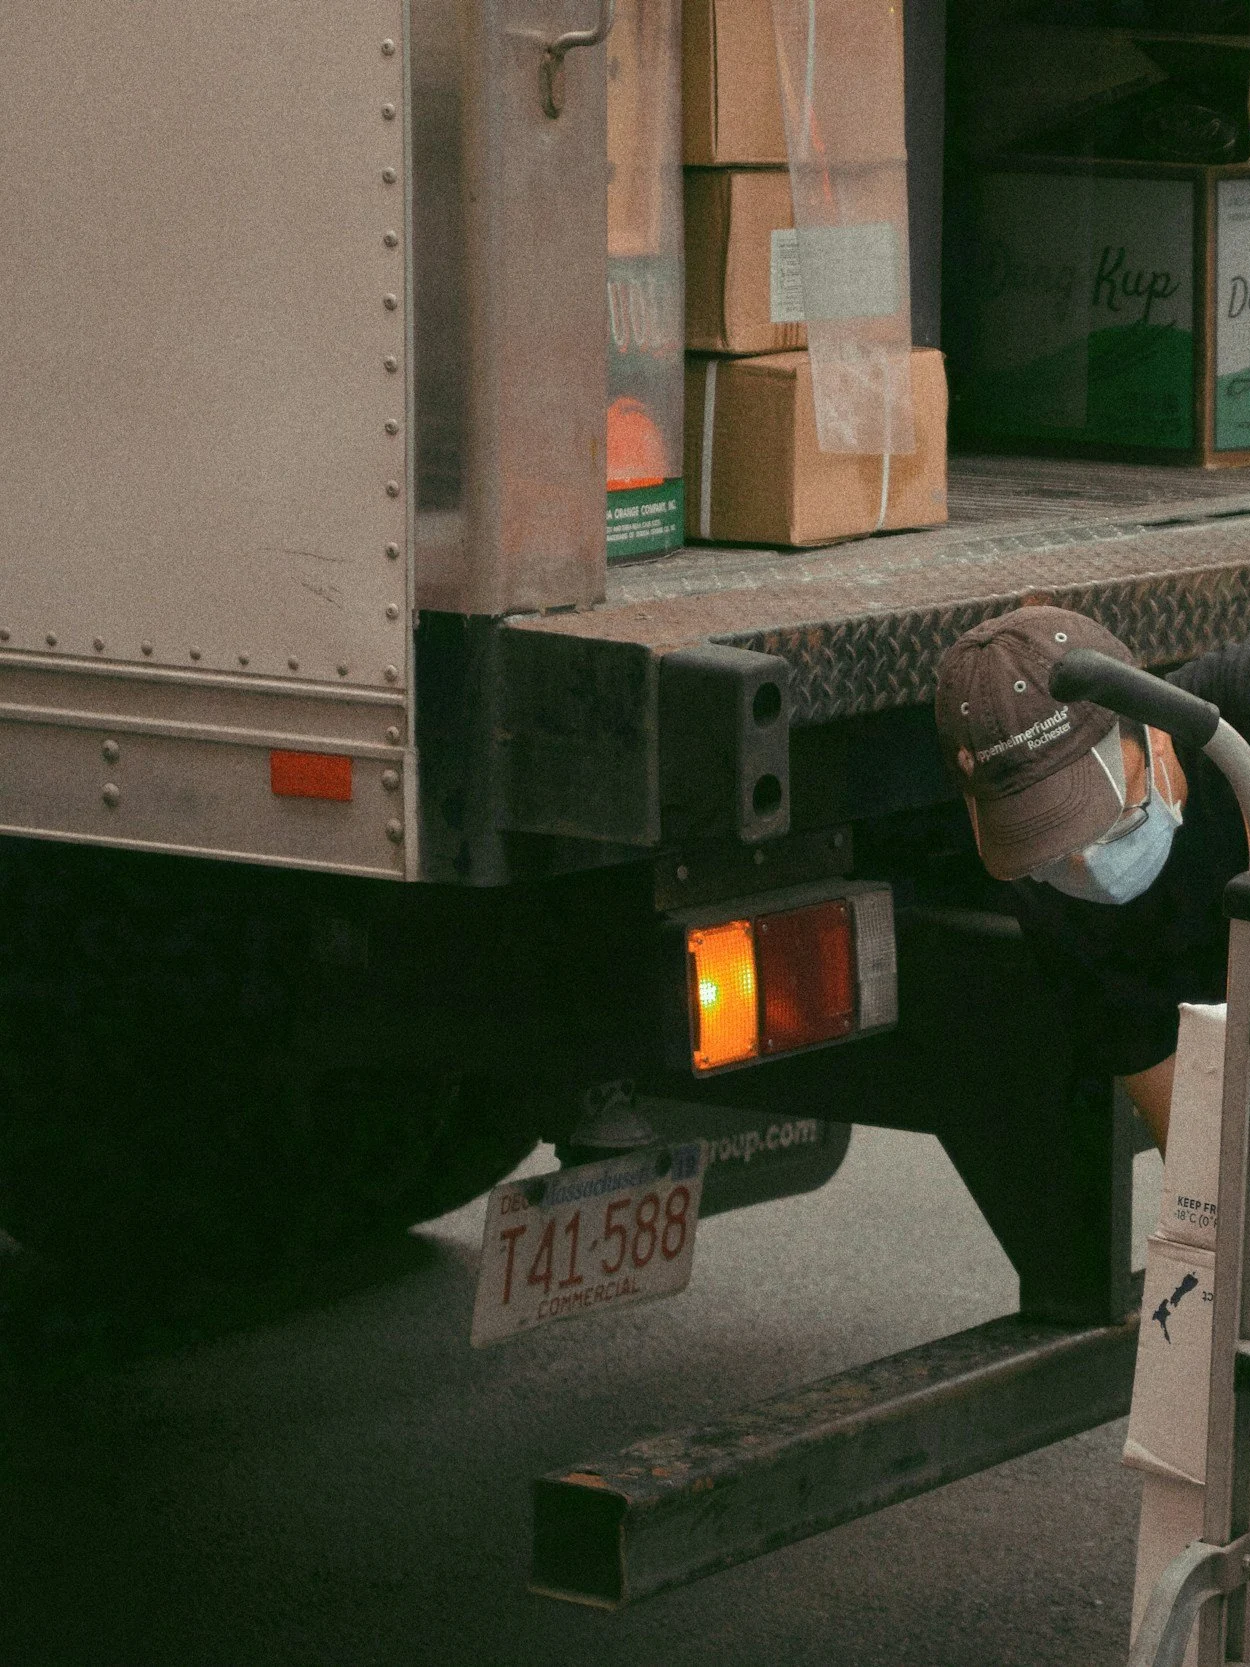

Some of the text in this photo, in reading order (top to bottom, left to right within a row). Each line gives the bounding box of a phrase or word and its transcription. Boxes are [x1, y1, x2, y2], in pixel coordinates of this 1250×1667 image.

[1093, 246, 1181, 322] Kup
[977, 706, 1068, 762] ppenheimerFunds
[1027, 722, 1071, 750] Rochester
[703, 1119, 817, 1163] roup.com
[1177, 1195, 1201, 1208] KEEP
[537, 1277, 640, 1319] COMMERCIAL
